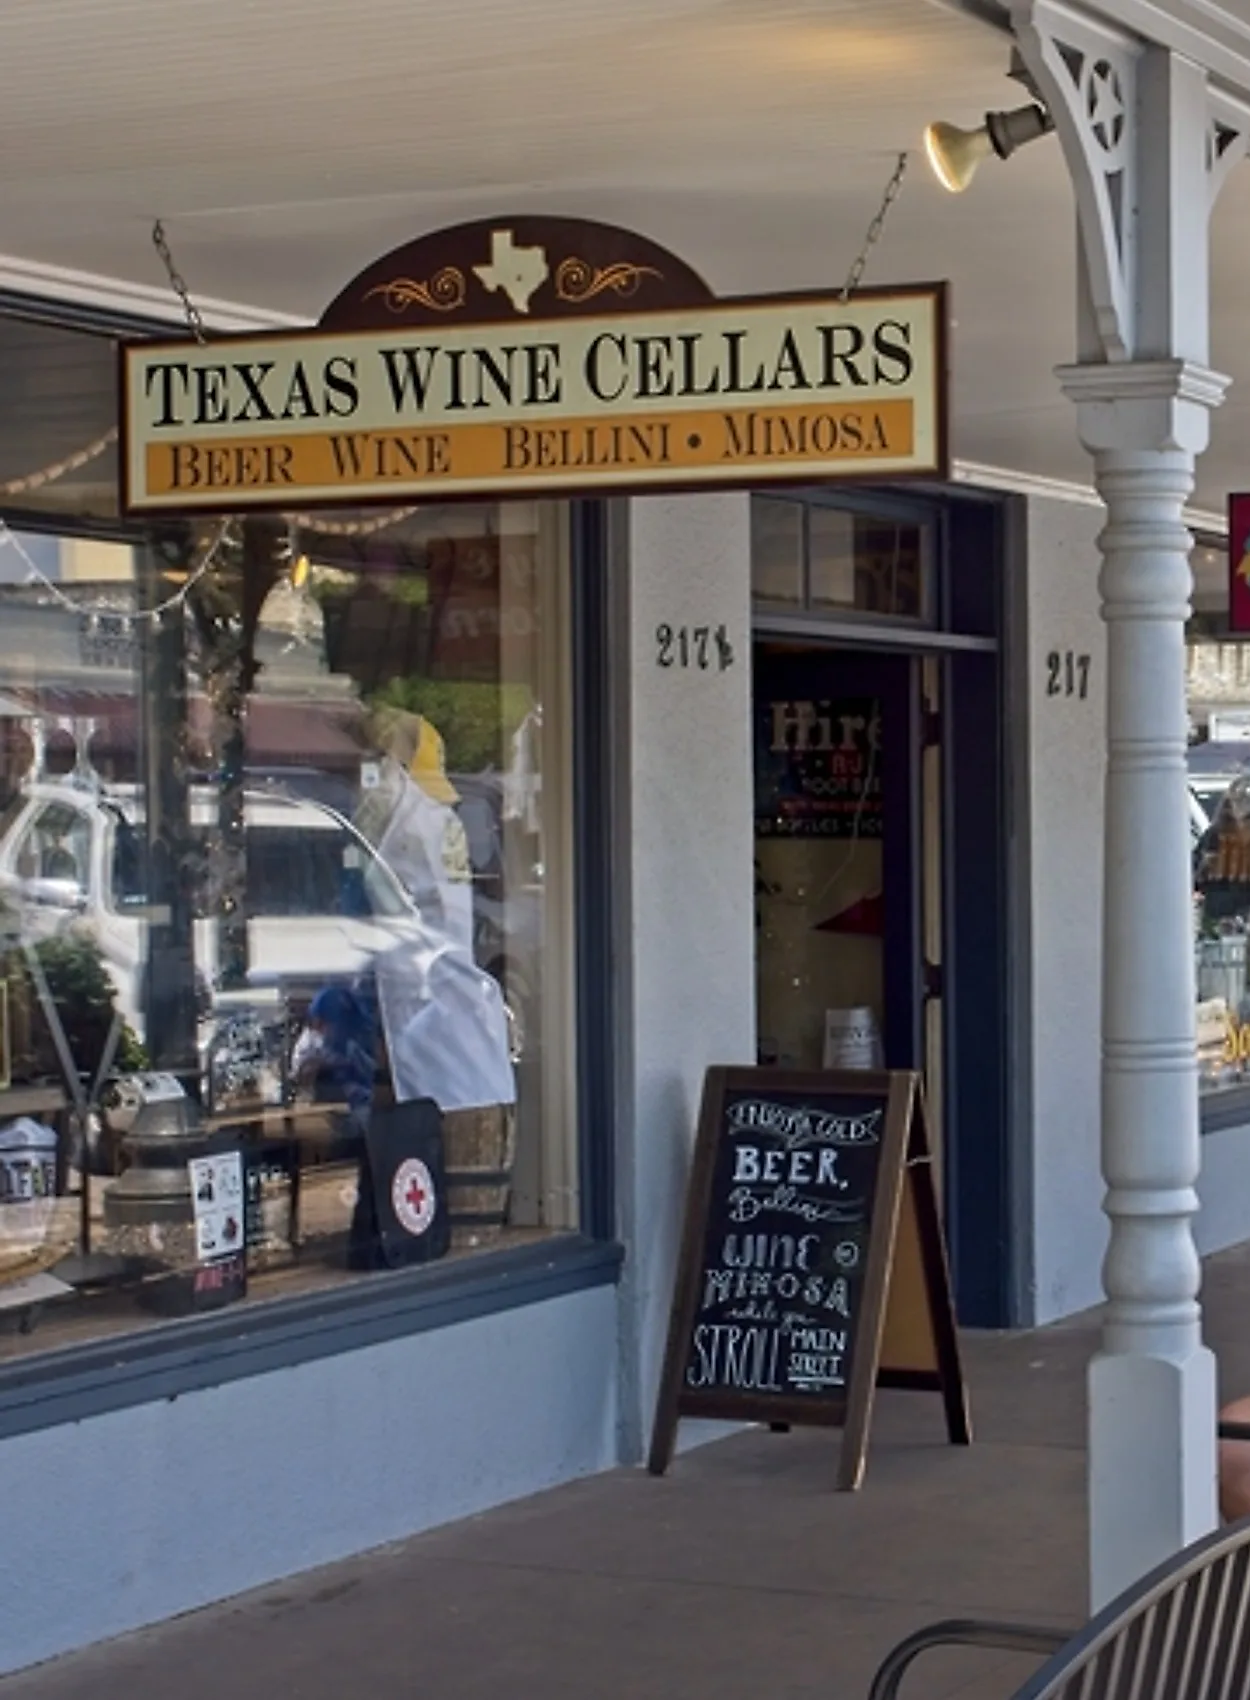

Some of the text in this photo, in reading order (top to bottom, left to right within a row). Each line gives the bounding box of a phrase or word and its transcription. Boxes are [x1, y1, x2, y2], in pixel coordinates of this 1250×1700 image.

[145, 318, 914, 428] TEXAS WINE CELLARS
[168, 411, 889, 490] BEER WINE BELLINI MIMOSA
[1045, 650, 1092, 701] 217
[732, 1145, 848, 1190] BEER,
[702, 1270, 850, 1318] MIMOSA
[686, 1324, 846, 1392] STROLL MAIN
